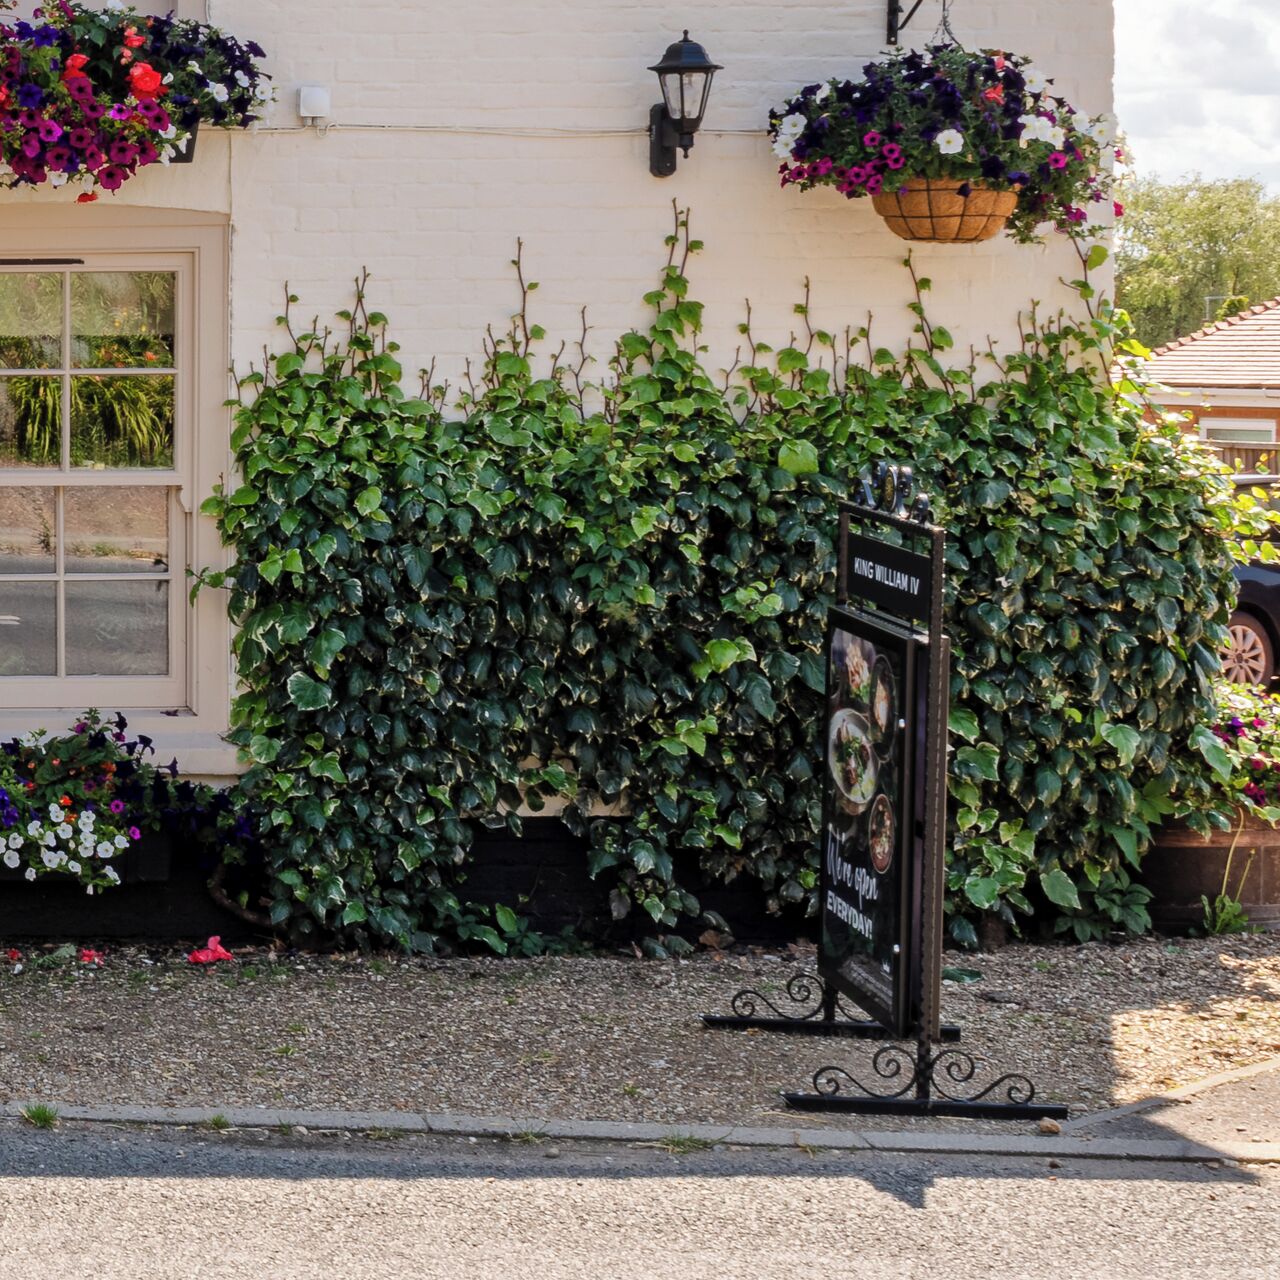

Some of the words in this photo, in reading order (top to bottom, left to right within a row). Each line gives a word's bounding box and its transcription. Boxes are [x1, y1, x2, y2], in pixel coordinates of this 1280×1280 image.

[854, 557, 874, 579] KING
[875, 563, 909, 592] WILLIAM
[910, 576, 920, 595] IV
[854, 867, 878, 910] open
[827, 890, 873, 940] EVERYDAY!
